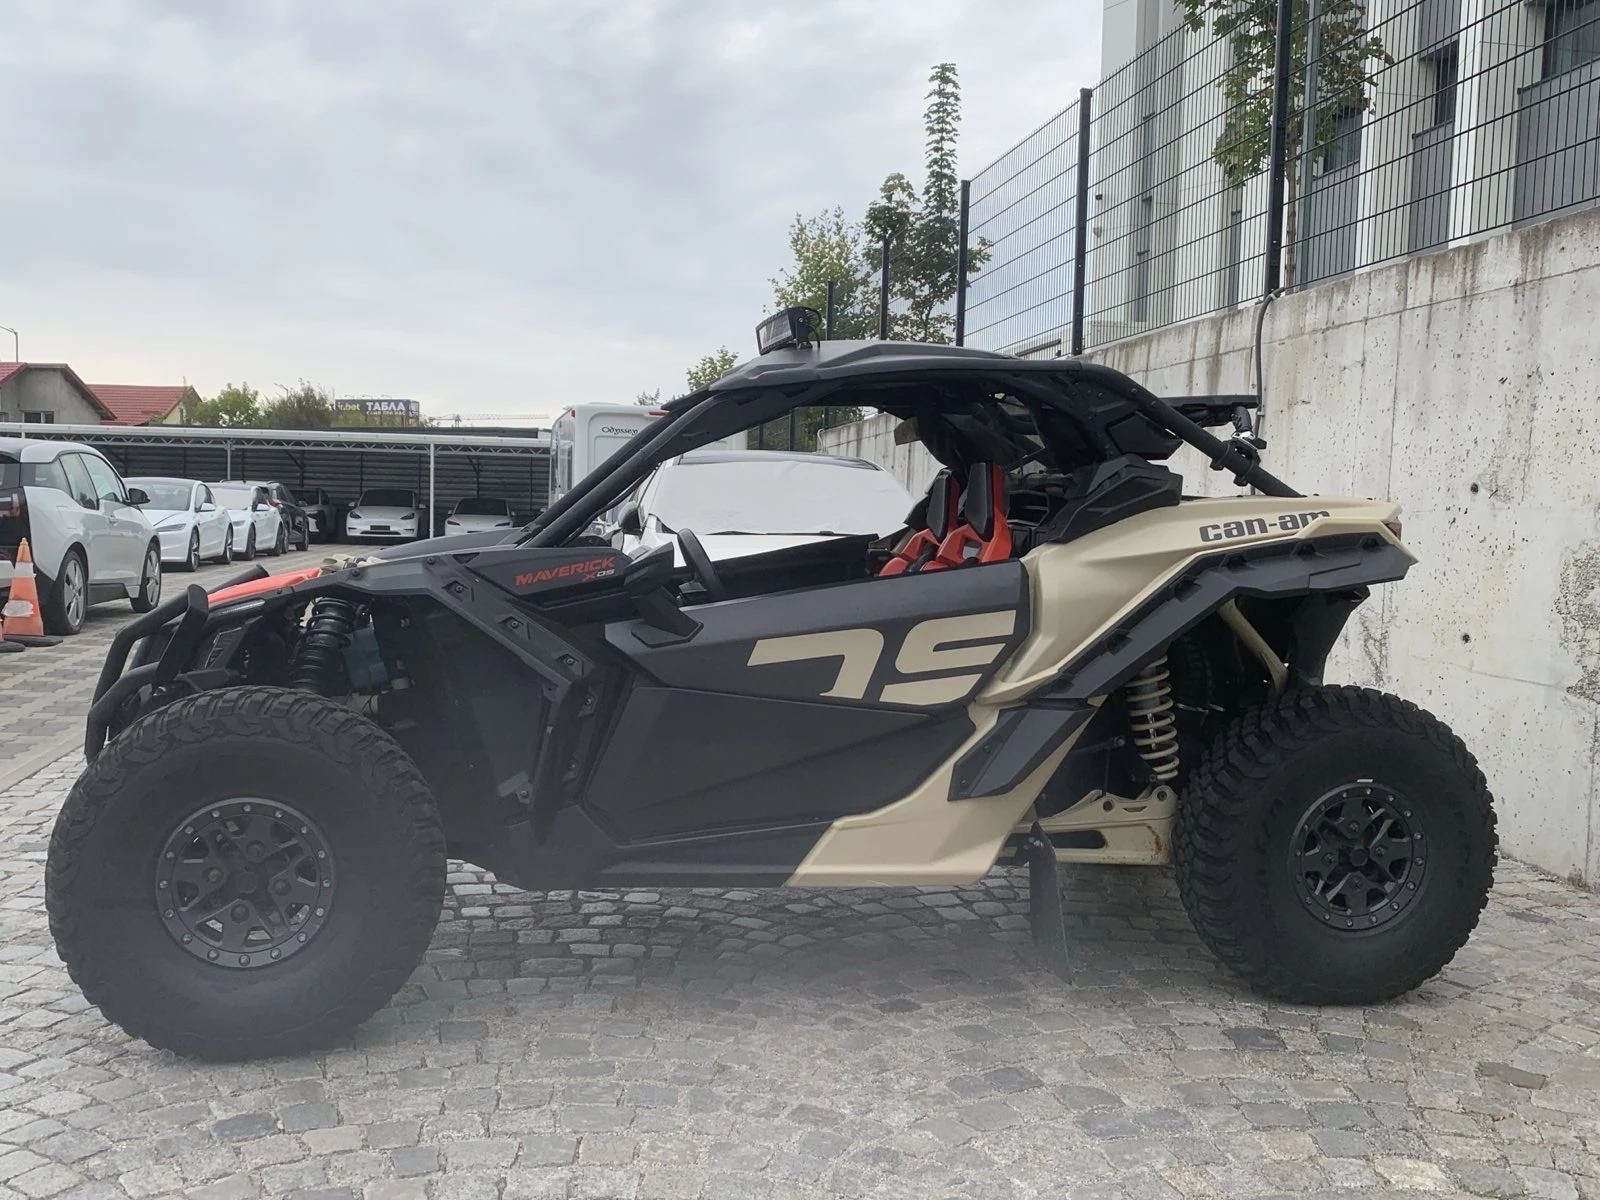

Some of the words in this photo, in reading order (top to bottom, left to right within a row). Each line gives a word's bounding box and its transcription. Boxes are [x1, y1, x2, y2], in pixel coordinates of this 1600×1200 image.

[366, 402, 406, 411] ТАБЛА
[601, 426, 639, 436] Odyssey
[515, 556, 616, 586] MAVERICK
